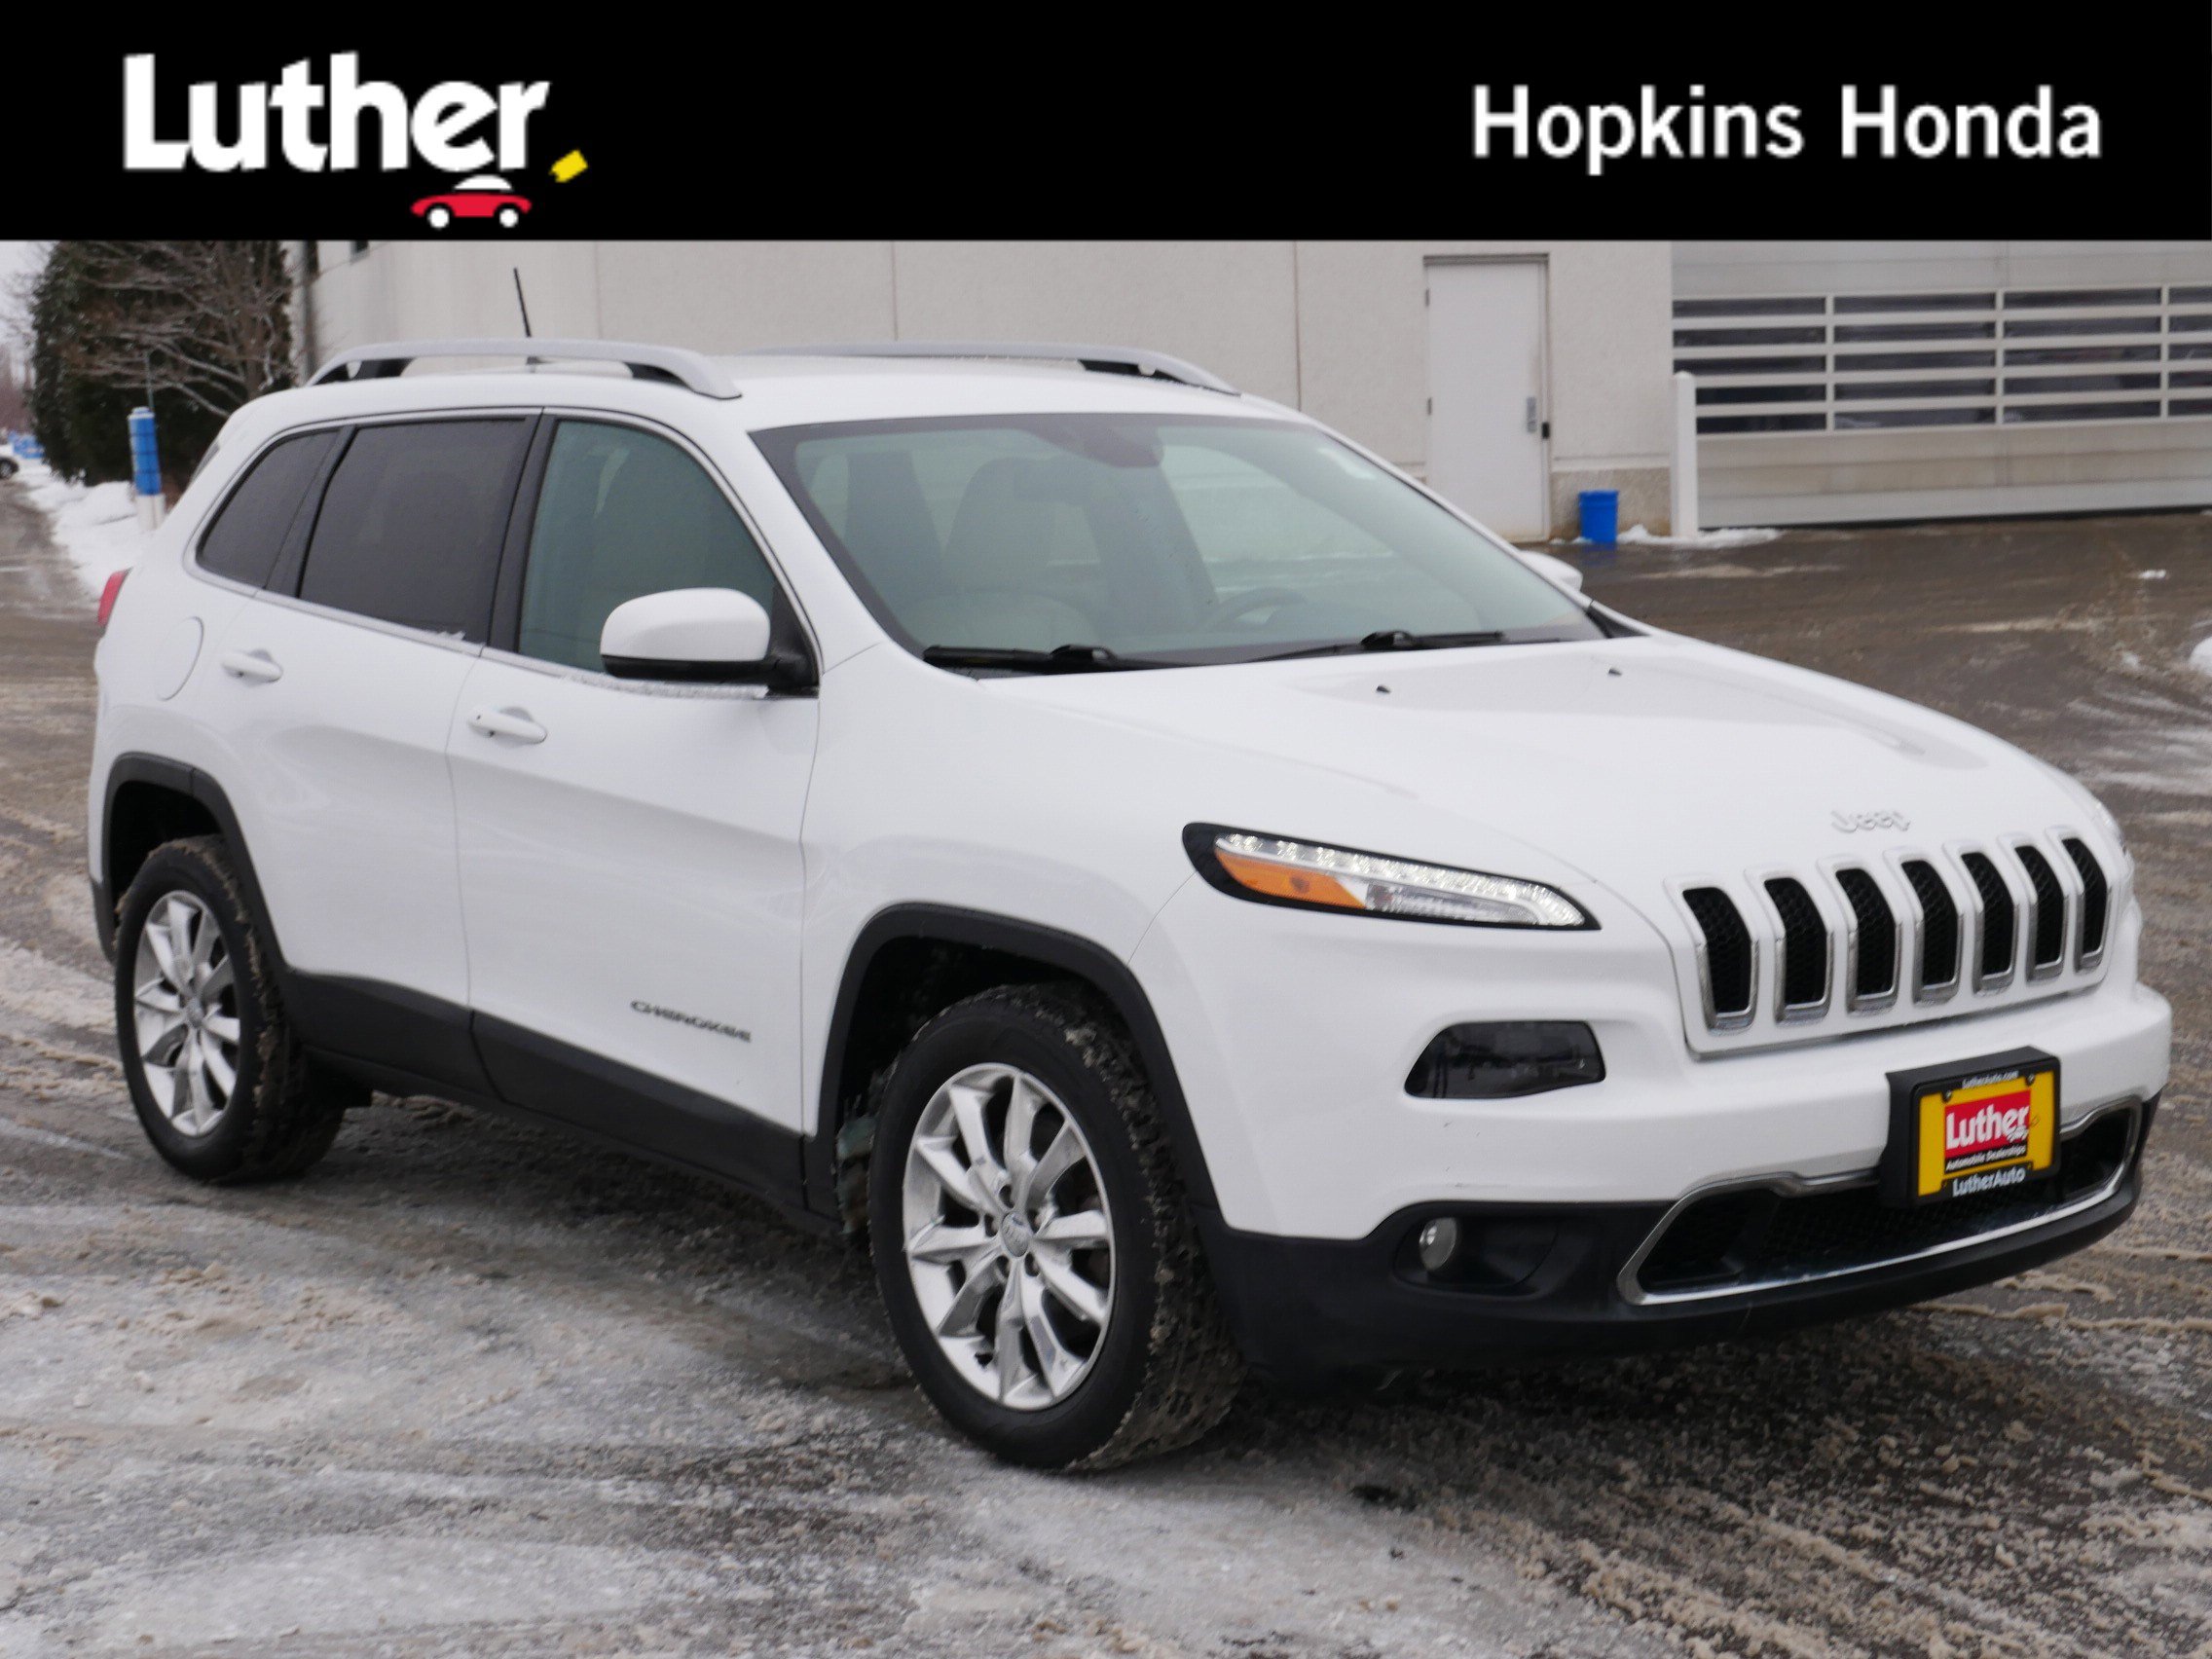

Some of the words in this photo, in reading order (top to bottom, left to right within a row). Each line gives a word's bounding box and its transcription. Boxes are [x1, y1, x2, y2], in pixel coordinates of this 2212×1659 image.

[1830, 810, 1910, 833] Jeep
[1946, 1103, 2030, 1151] Luther
[1952, 1165, 2026, 1198] LutherAuto
